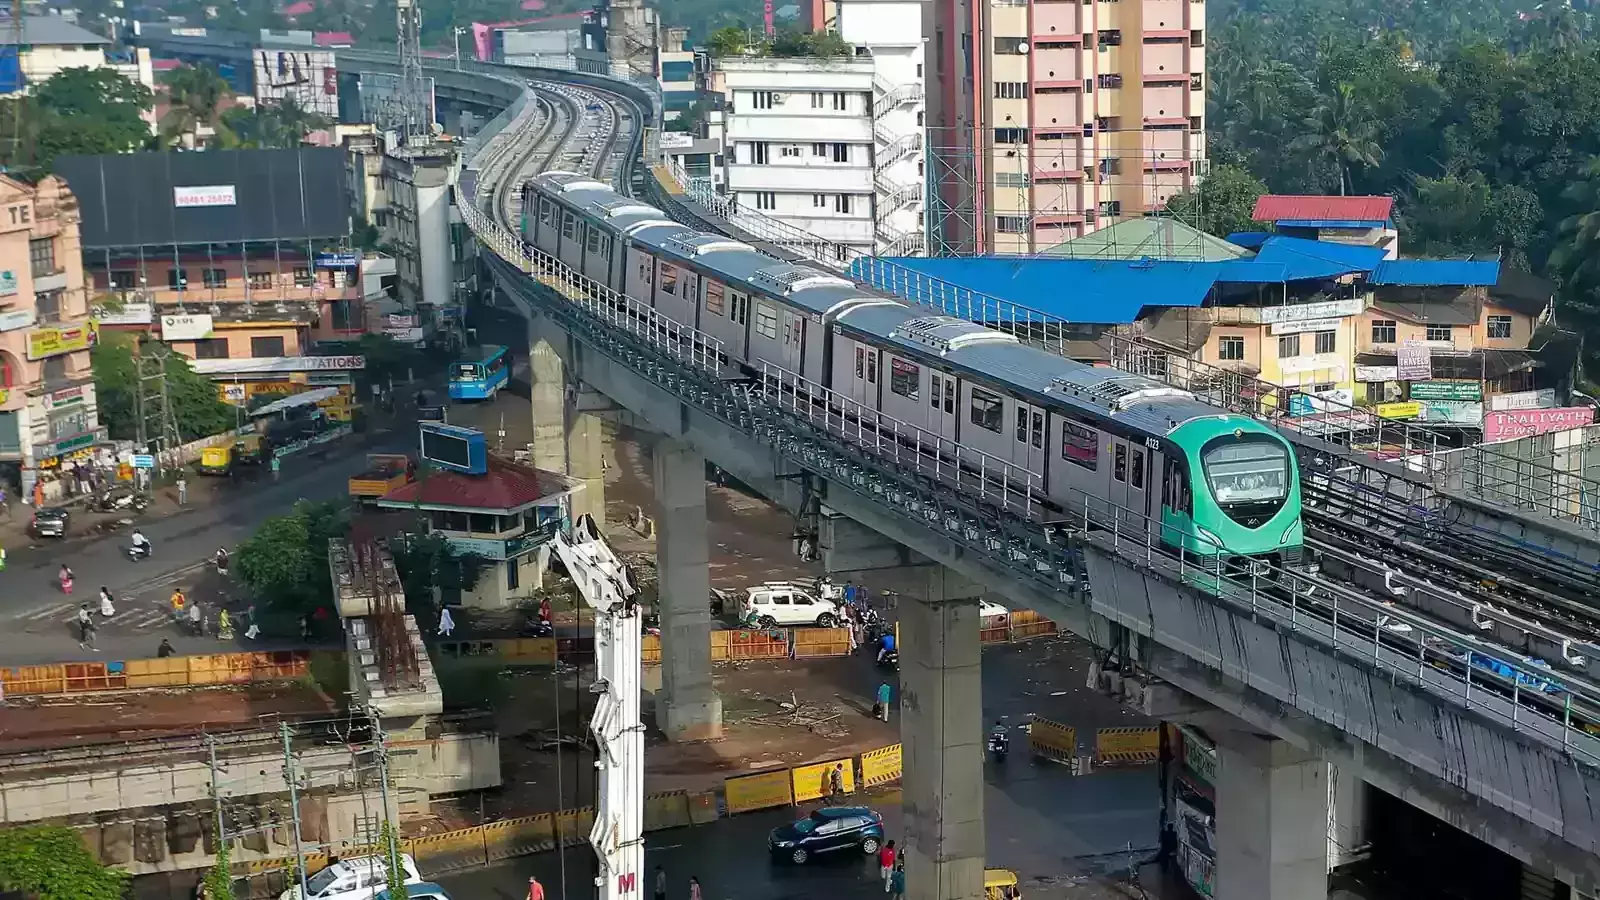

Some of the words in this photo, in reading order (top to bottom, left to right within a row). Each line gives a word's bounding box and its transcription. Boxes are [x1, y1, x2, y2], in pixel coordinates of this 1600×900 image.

[1400, 358, 1429, 366] TRAVELS
[1495, 411, 1585, 424] THALIYATH
[1145, 436, 1159, 450] A123
[618, 872, 635, 895] M
